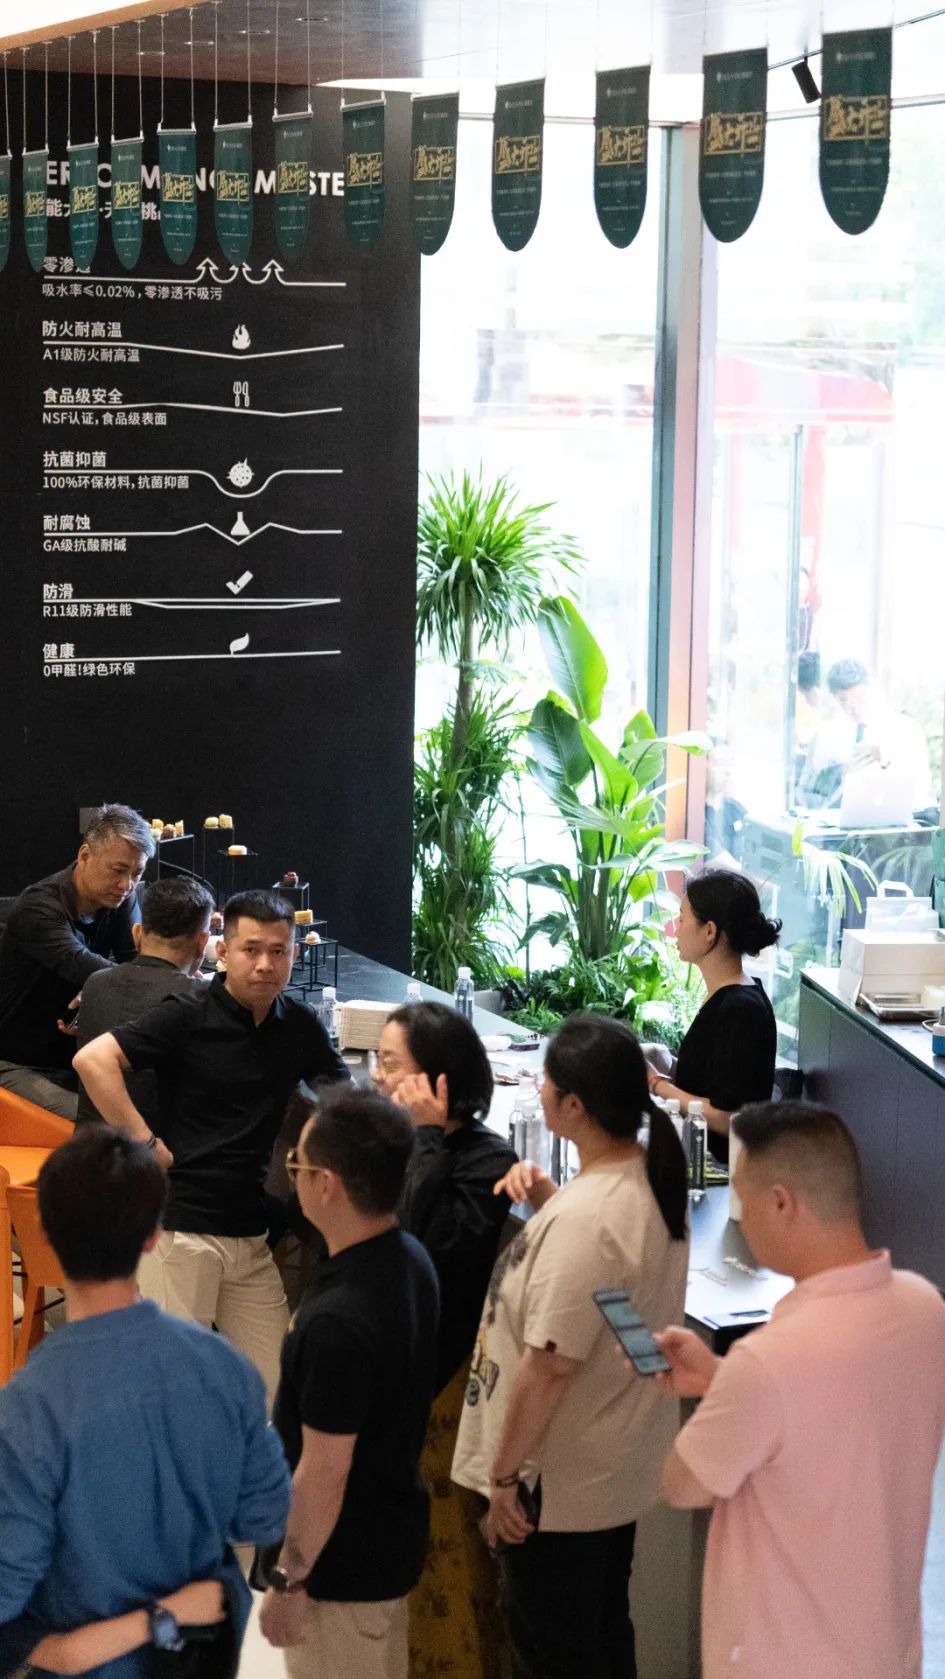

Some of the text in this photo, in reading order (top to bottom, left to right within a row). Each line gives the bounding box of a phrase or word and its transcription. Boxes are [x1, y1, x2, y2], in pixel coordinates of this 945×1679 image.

[42, 320, 122, 338] 防火耐高温
[42, 347, 140, 362] A1级防火耐高温
[43, 387, 123, 404] 食品级安全
[43, 451, 107, 467] 抗菌抑菌
[43, 514, 91, 531] 耐腐蚀
[43, 538, 127, 552] GA级抗酸耐碱
[43, 583, 73, 600] 防滑
[43, 603, 132, 617] R11级防滑性能
[43, 643, 75, 659] 健康
